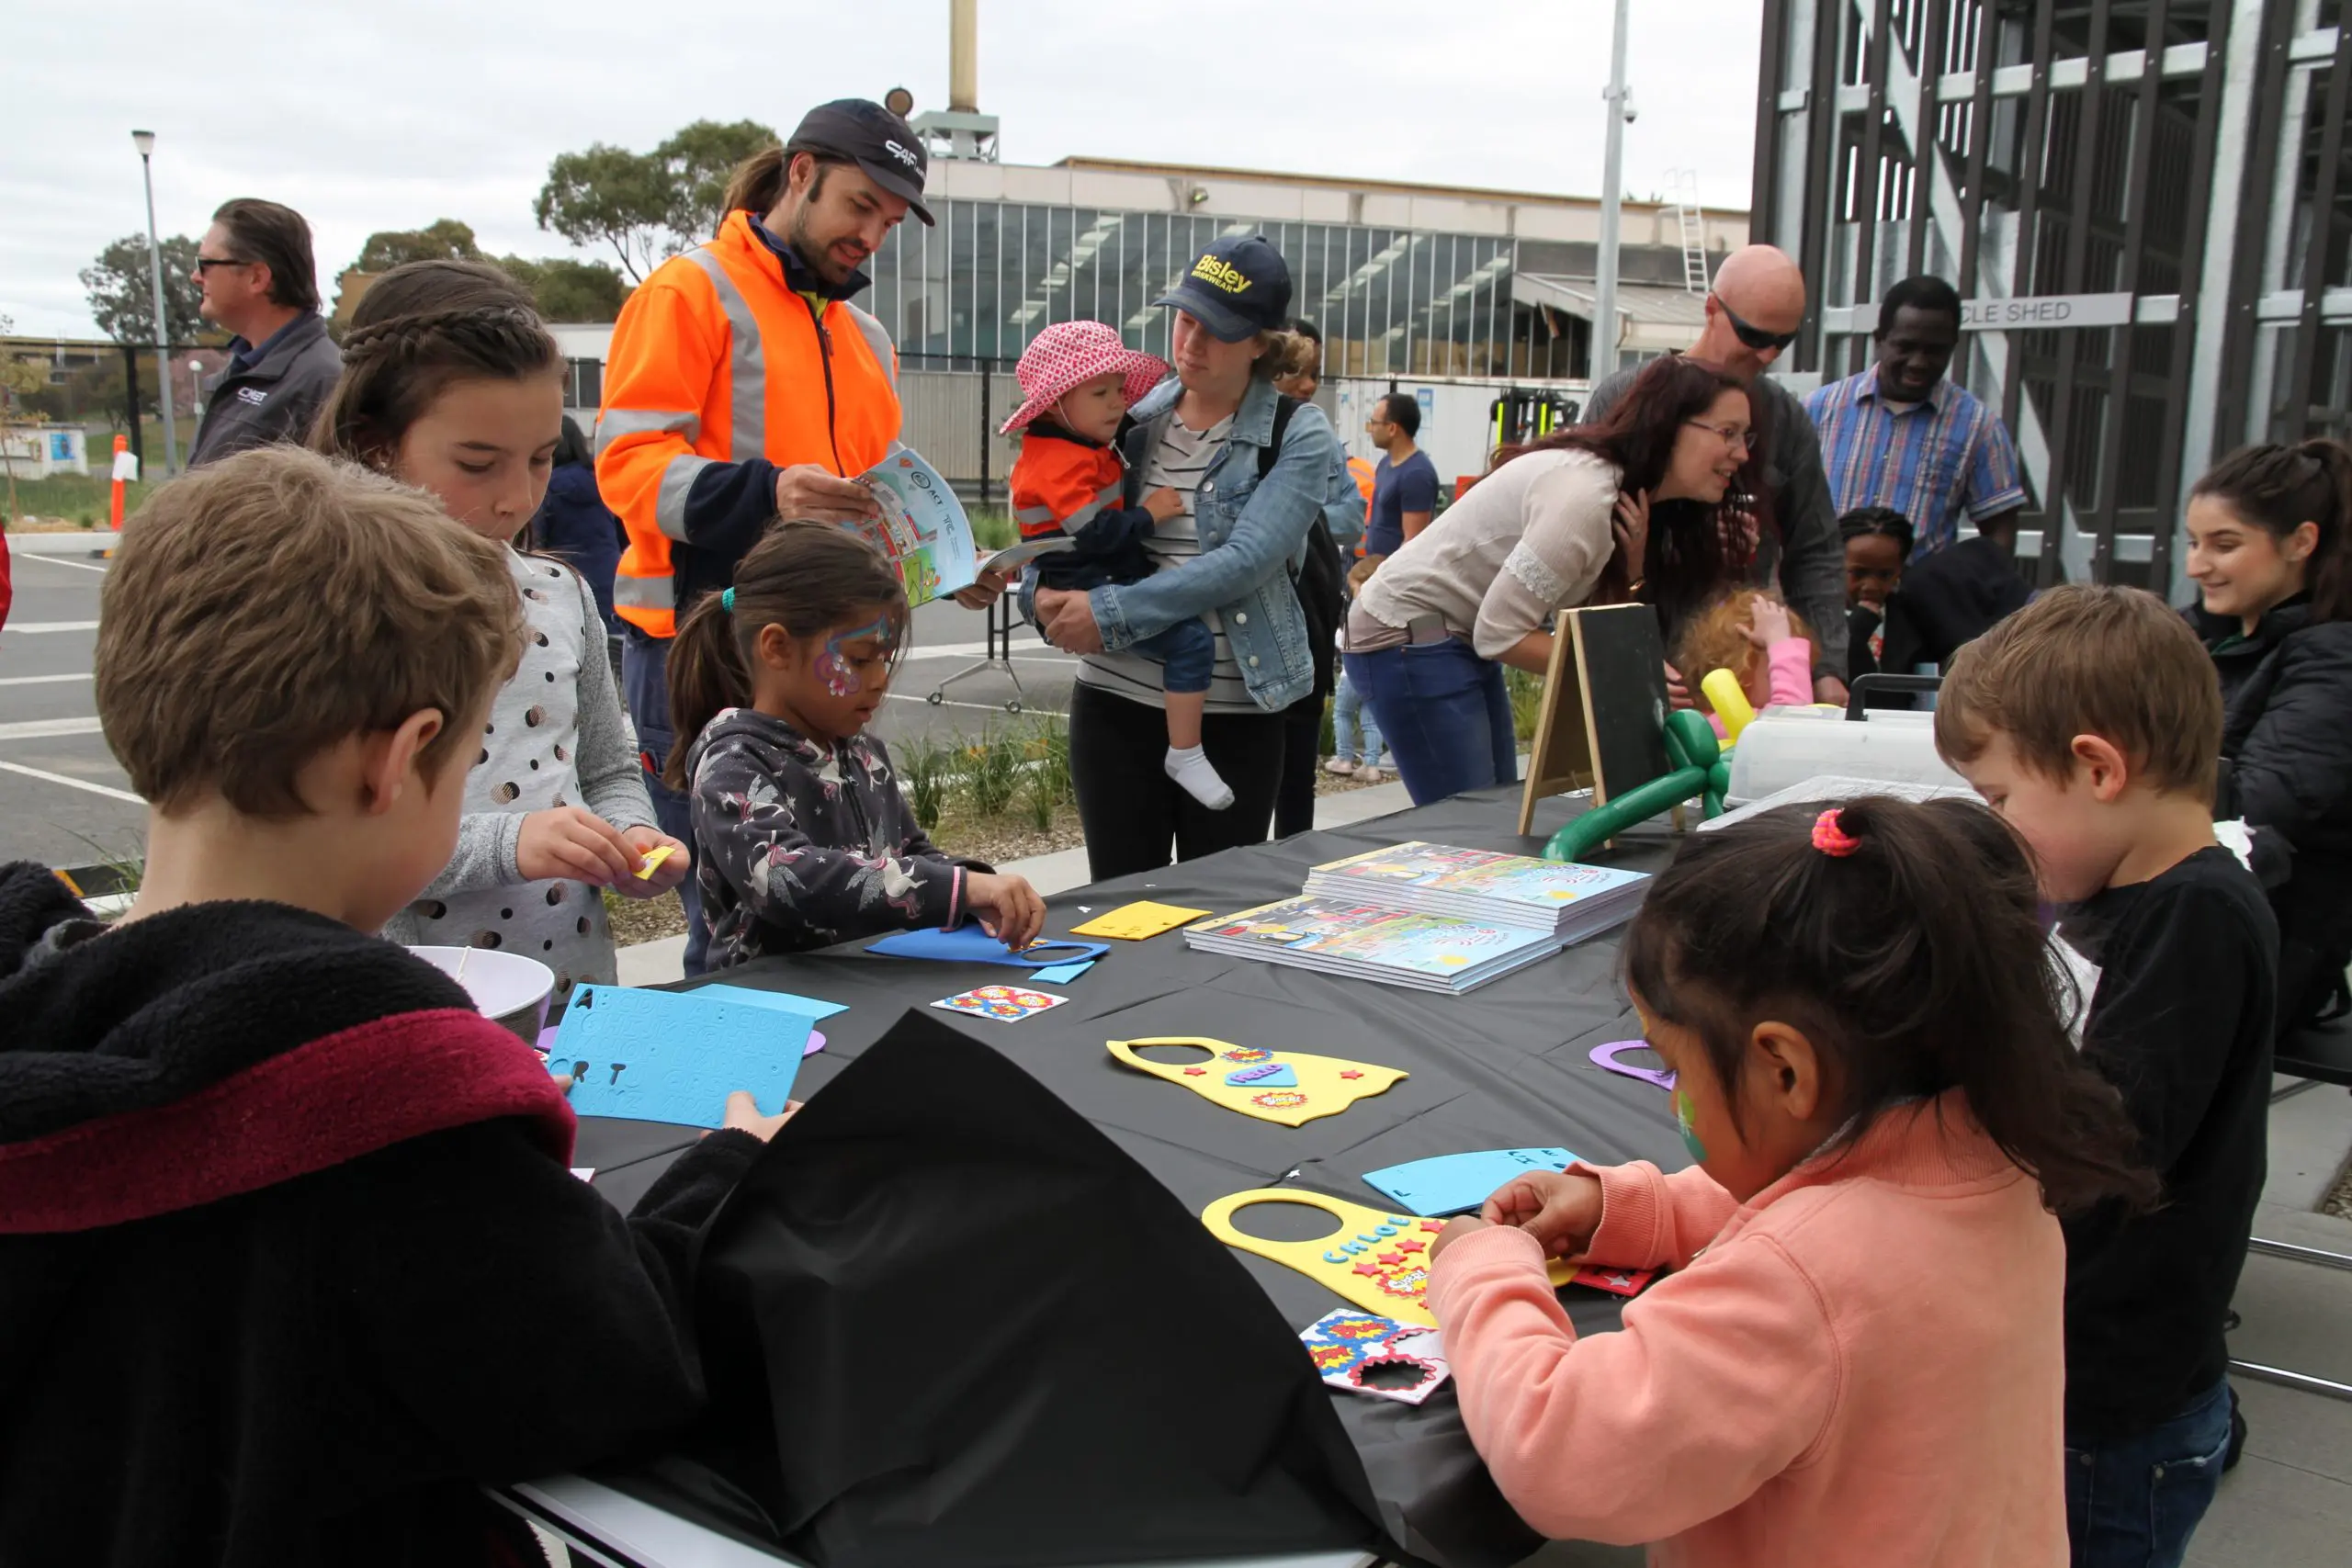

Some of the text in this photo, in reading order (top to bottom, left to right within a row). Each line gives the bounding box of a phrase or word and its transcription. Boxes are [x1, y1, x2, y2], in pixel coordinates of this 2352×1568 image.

[1196, 254, 1253, 294] Bisley
[1961, 301, 2072, 324] CLE SHED
[1230, 1064, 1283, 1084] HELLO
[1323, 1216, 1411, 1264] CHLOE
